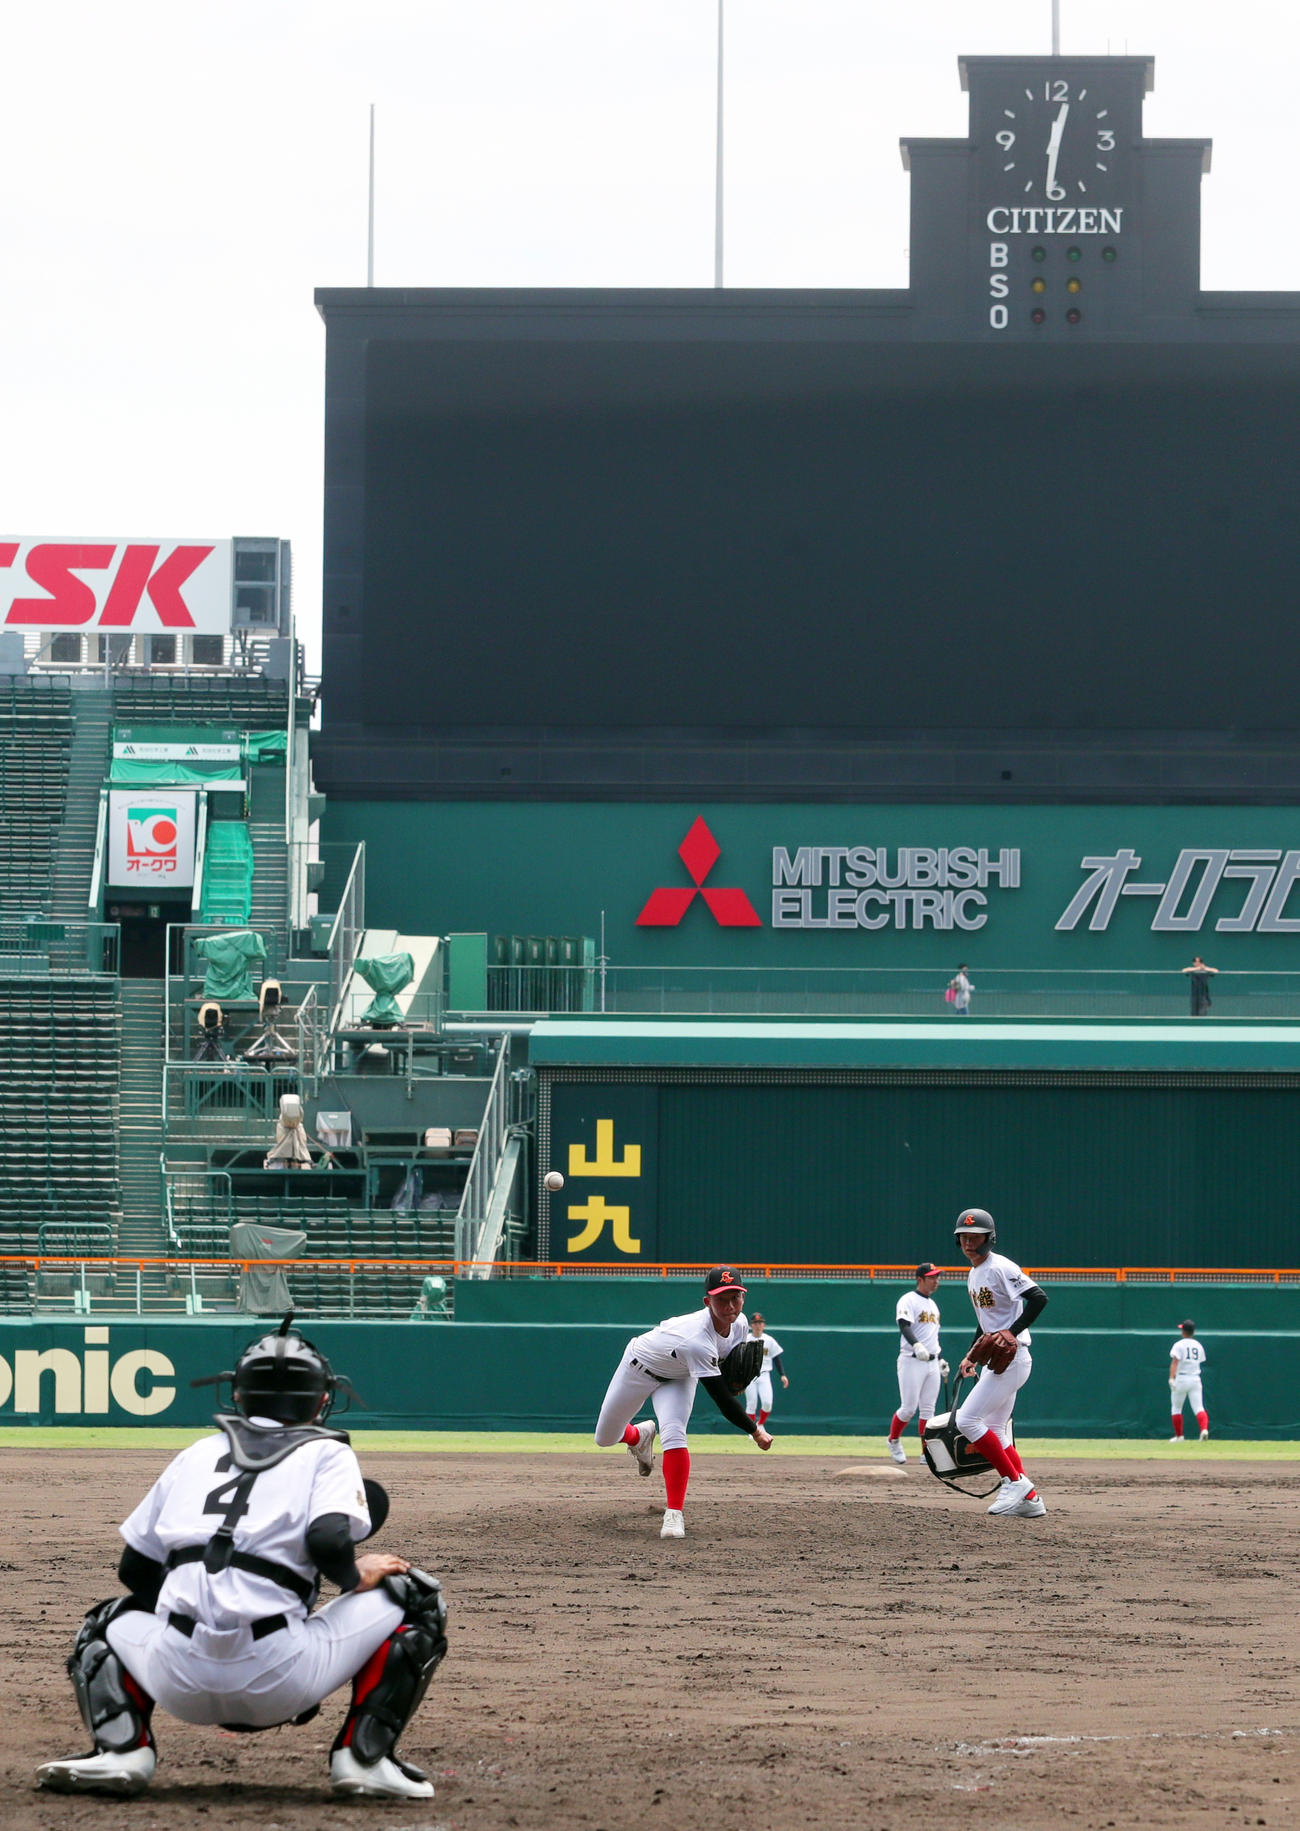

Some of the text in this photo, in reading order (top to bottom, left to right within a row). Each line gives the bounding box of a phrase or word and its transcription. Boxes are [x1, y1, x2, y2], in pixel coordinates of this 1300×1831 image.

[1045, 80, 1069, 102] 12
[995, 130, 1016, 151] 9
[1097, 130, 1116, 151] 3
[987, 207, 1123, 234] CITIZEN
[990, 243, 1009, 268] B
[990, 274, 1009, 298] S
[0, 543, 216, 627] SK
[127, 859, 177, 872] オークワ
[772, 847, 1020, 889] MITSUBISHI
[772, 889, 988, 930] ELECTRIC
[1186, 1347, 1199, 1360] 19
[0, 1326, 176, 1416] nic
